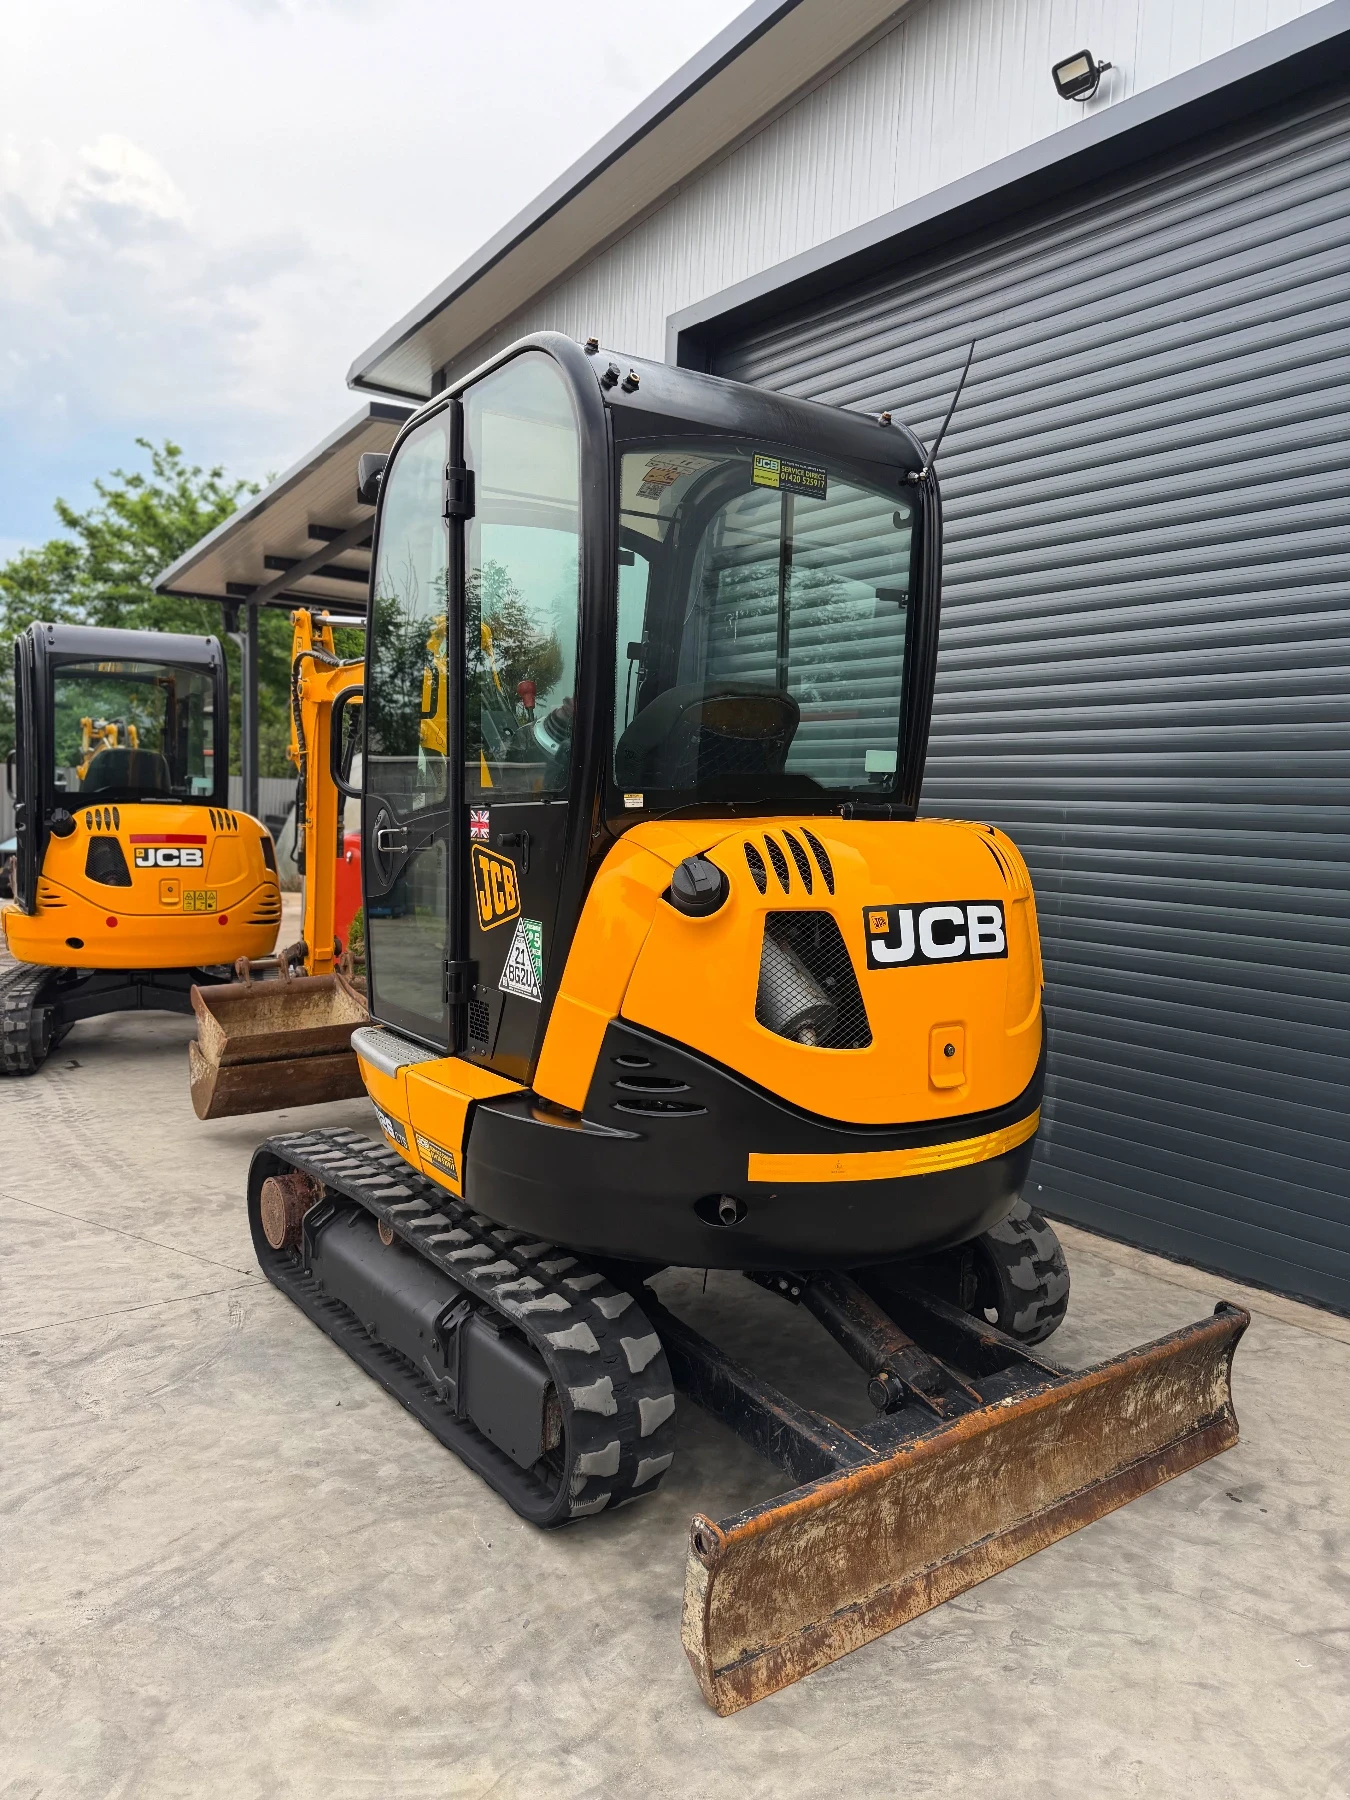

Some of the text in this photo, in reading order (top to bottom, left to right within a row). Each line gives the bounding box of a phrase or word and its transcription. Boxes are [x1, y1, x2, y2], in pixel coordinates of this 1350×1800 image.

[757, 458, 777, 470] JCB
[781, 466, 804, 477] SERVICE
[805, 471, 825, 481] DIRECT
[781, 472, 801, 483] 01420
[802, 477, 825, 488] 525917
[136, 849, 202, 866] JCB
[479, 855, 516, 921] JCB
[871, 905, 1005, 963] JCB
[515, 947, 525, 966] 21
